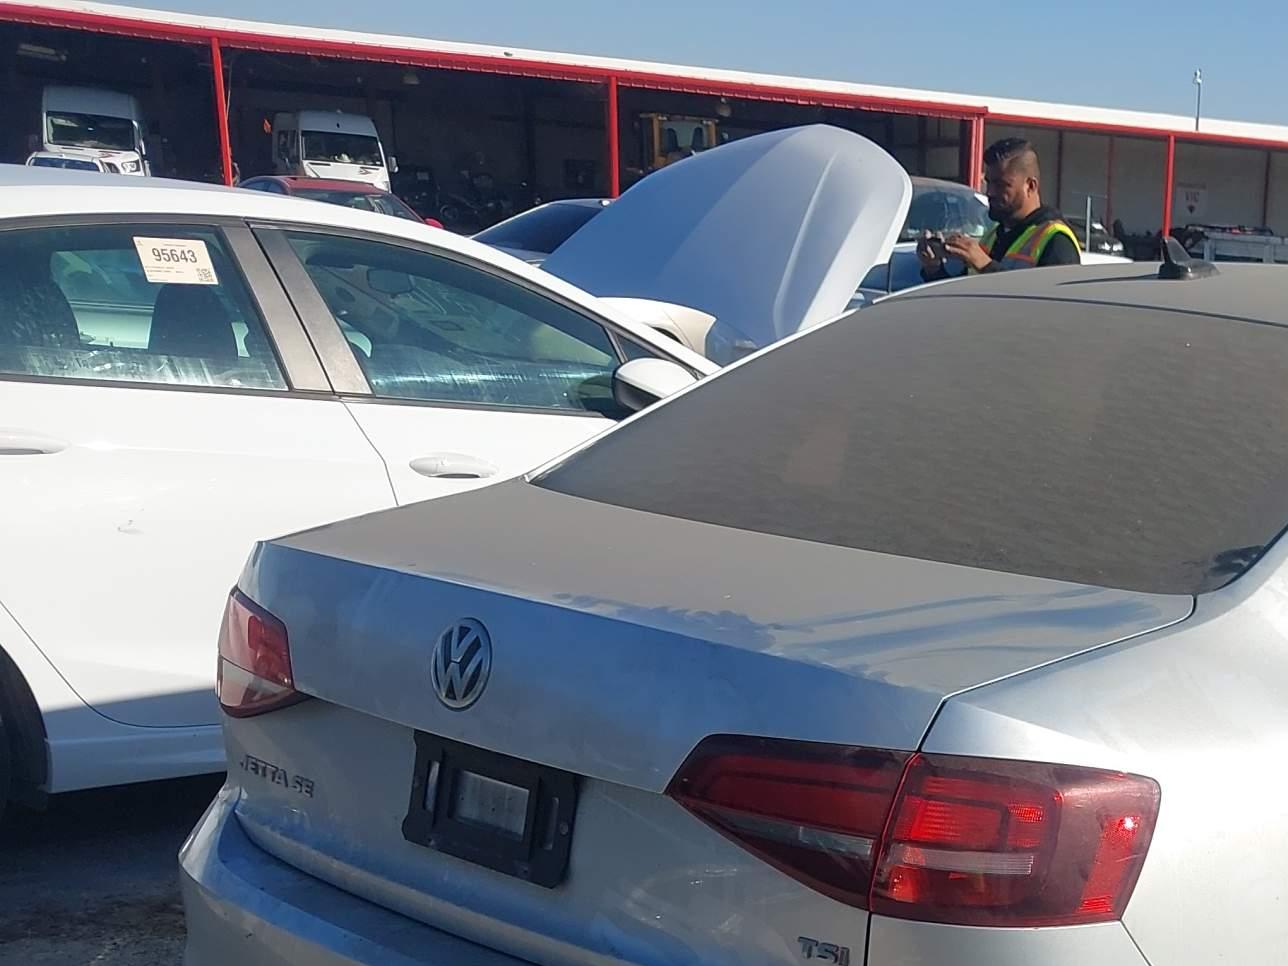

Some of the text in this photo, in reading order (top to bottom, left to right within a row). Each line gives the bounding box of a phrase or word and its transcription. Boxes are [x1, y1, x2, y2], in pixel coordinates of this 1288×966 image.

[151, 247, 198, 264] 95643
[240, 754, 315, 798] JETTA SE
